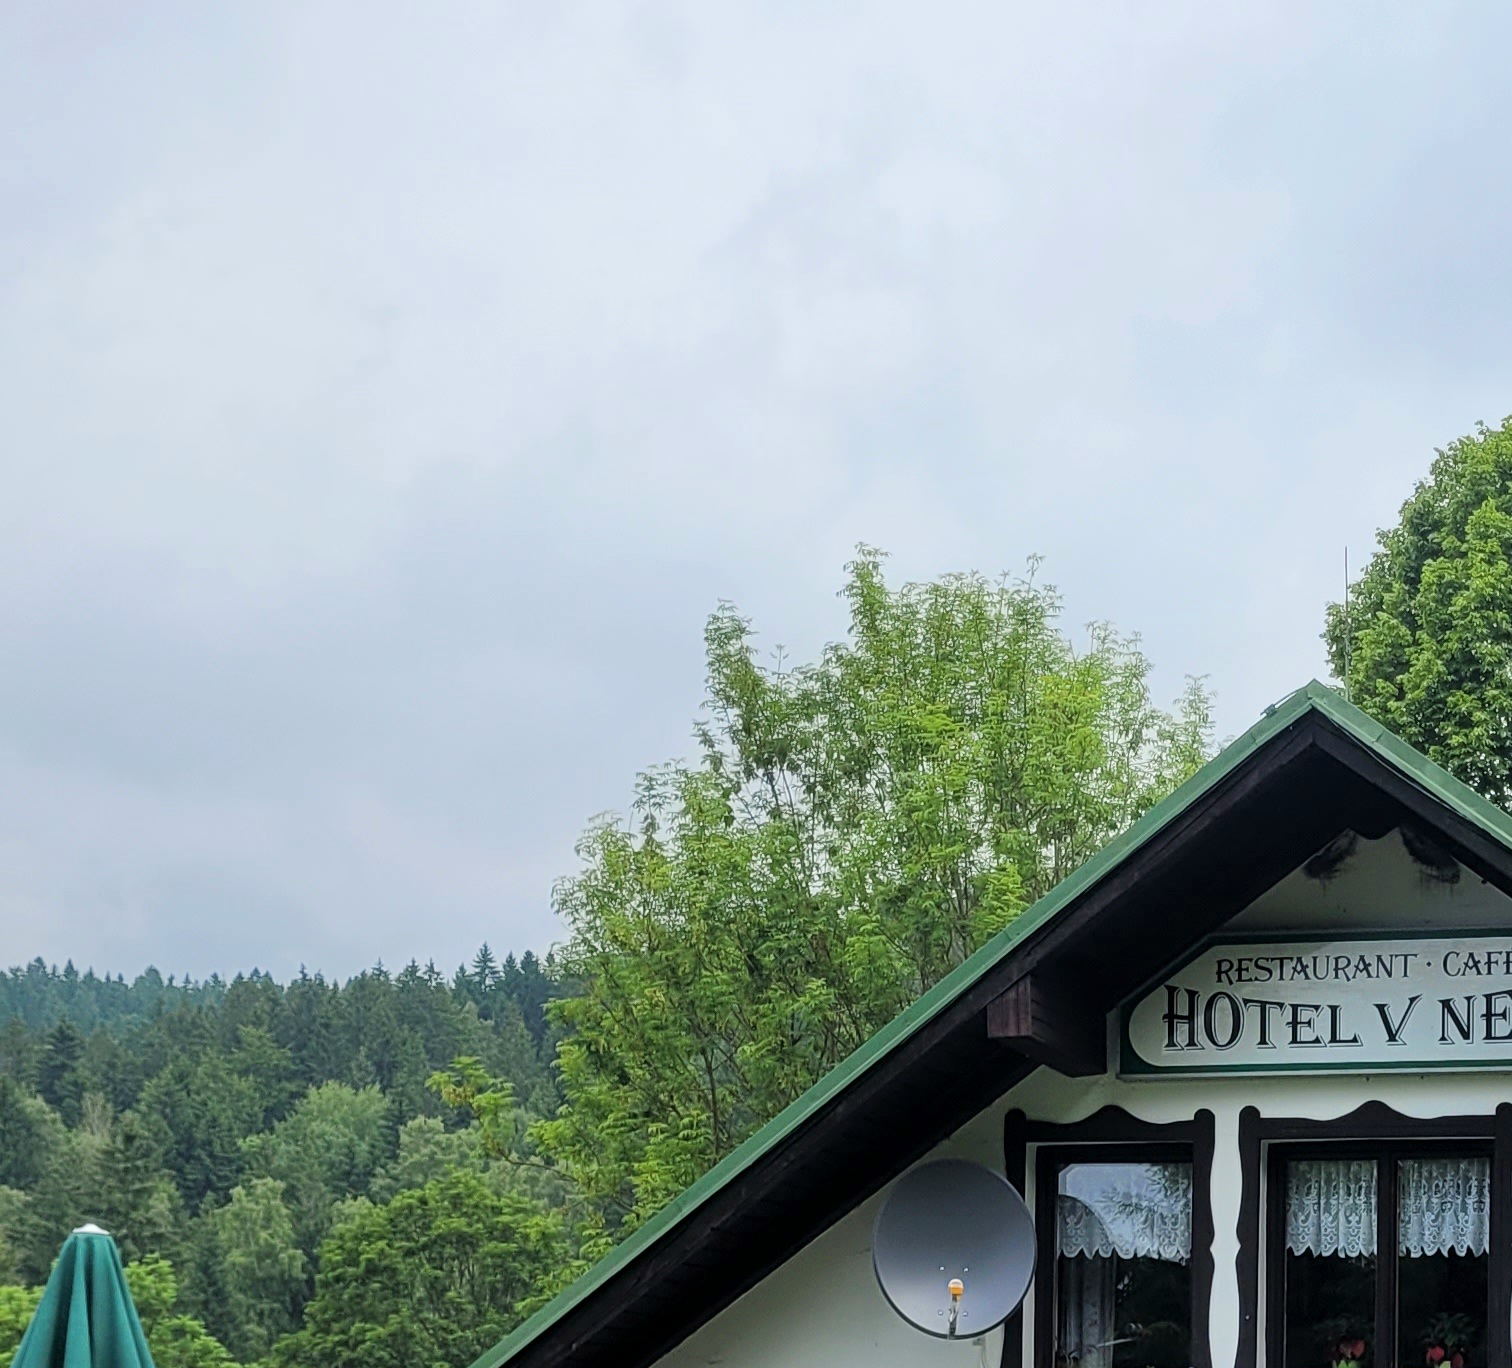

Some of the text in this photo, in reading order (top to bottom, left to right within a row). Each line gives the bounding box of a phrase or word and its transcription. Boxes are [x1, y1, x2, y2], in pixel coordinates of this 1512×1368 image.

[1215, 953, 1418, 986] RESTAURANT
[1162, 984, 1364, 1051] HOTEL
[1373, 993, 1424, 1046] V
